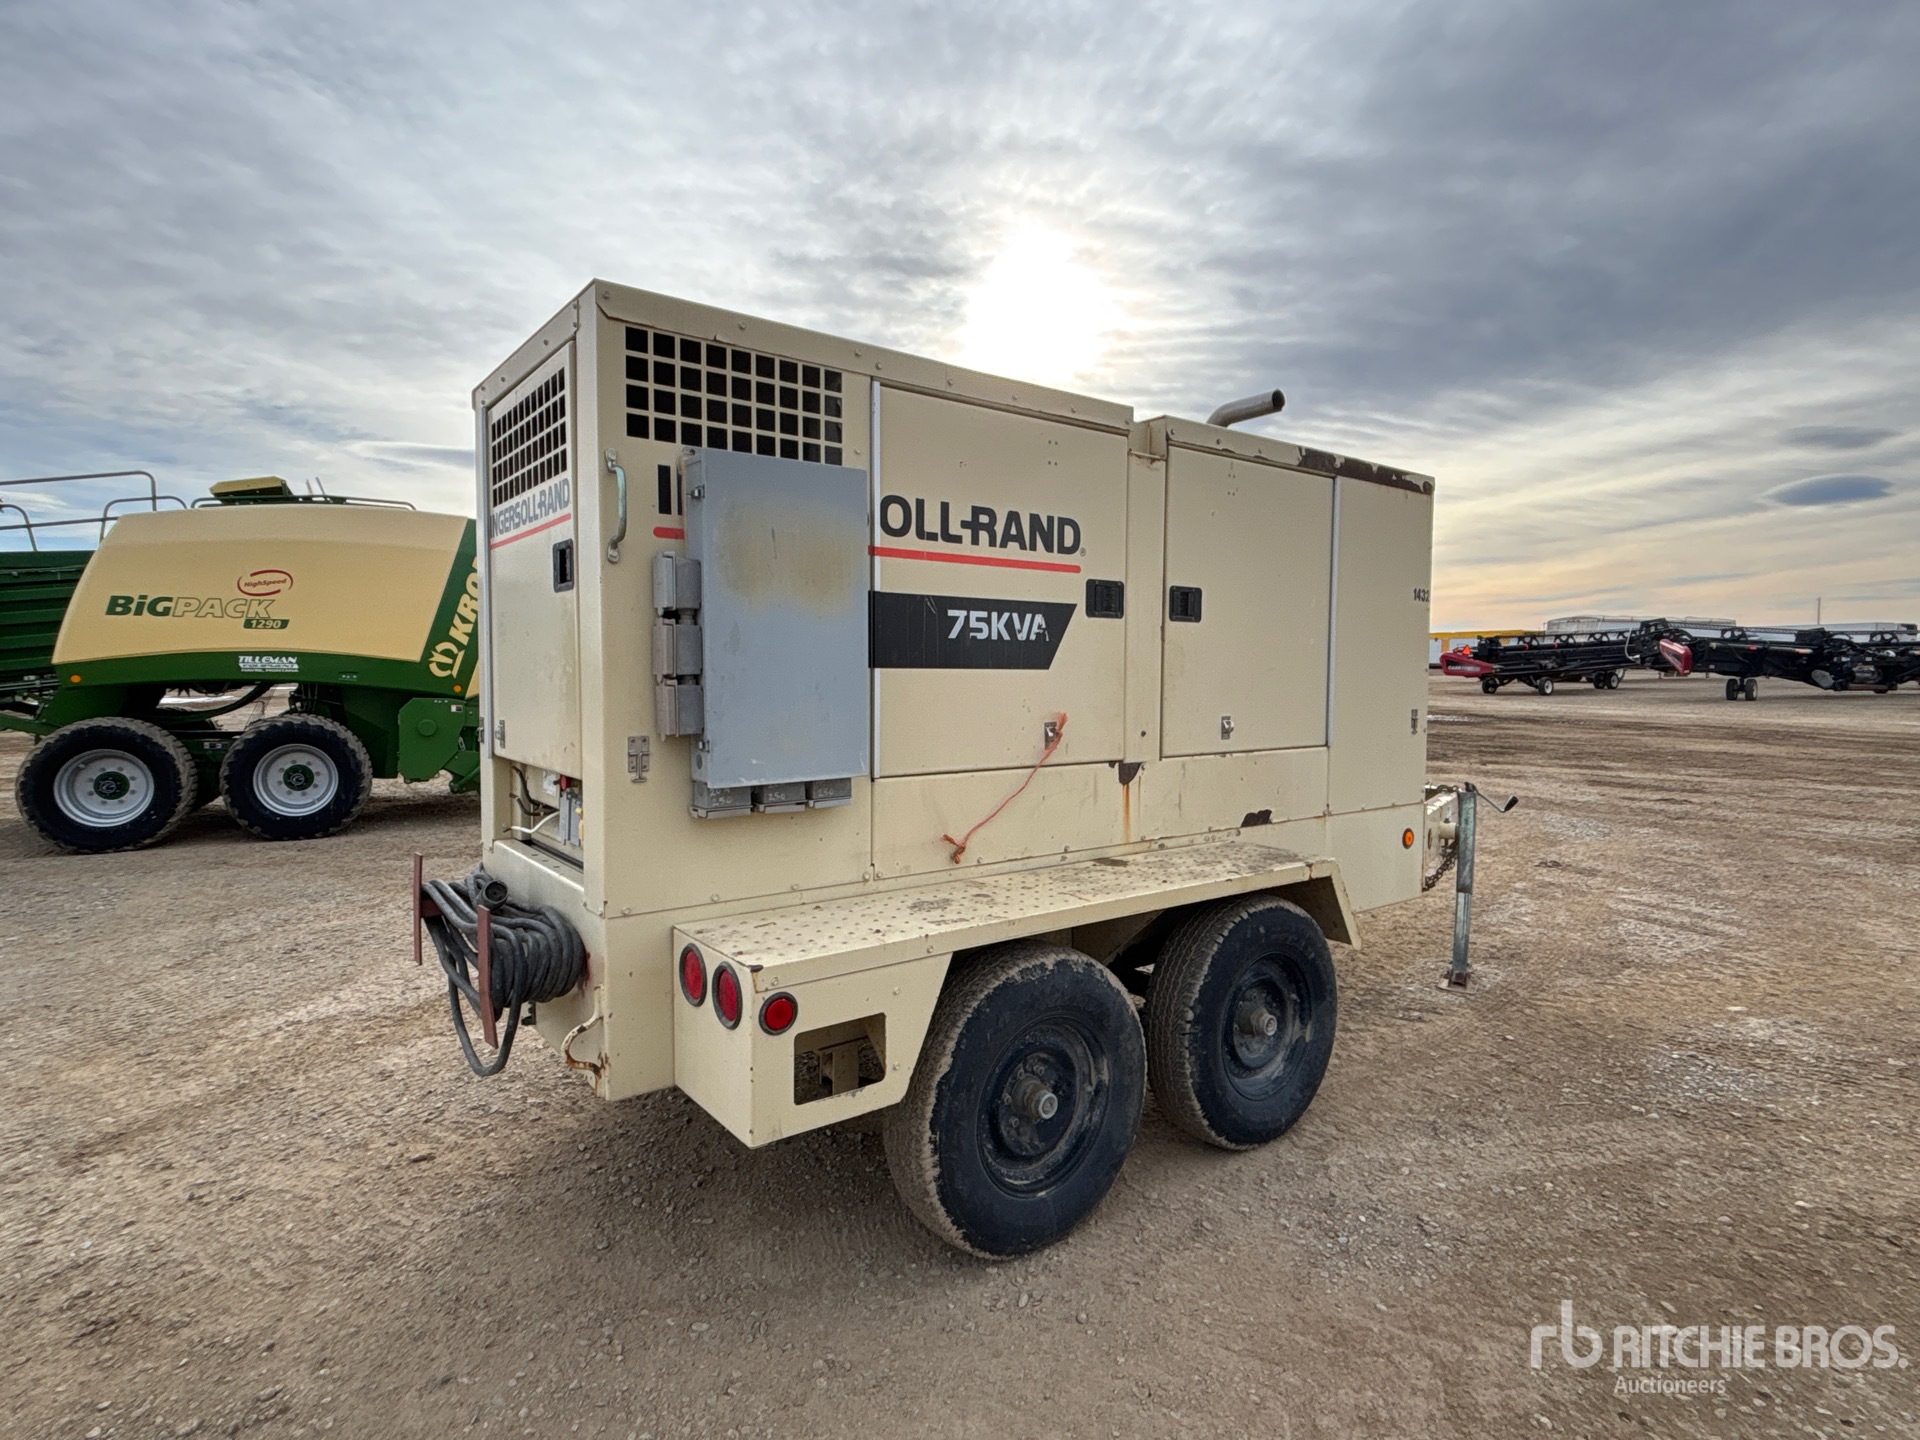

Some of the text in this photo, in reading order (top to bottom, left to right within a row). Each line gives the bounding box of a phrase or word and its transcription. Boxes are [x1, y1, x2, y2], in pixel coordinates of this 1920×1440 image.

[243, 578, 288, 588] HighSpeed
[250, 619, 282, 629] 1290
[947, 609, 1050, 641] 75KVA
[238, 655, 298, 664] TILLEMAN
